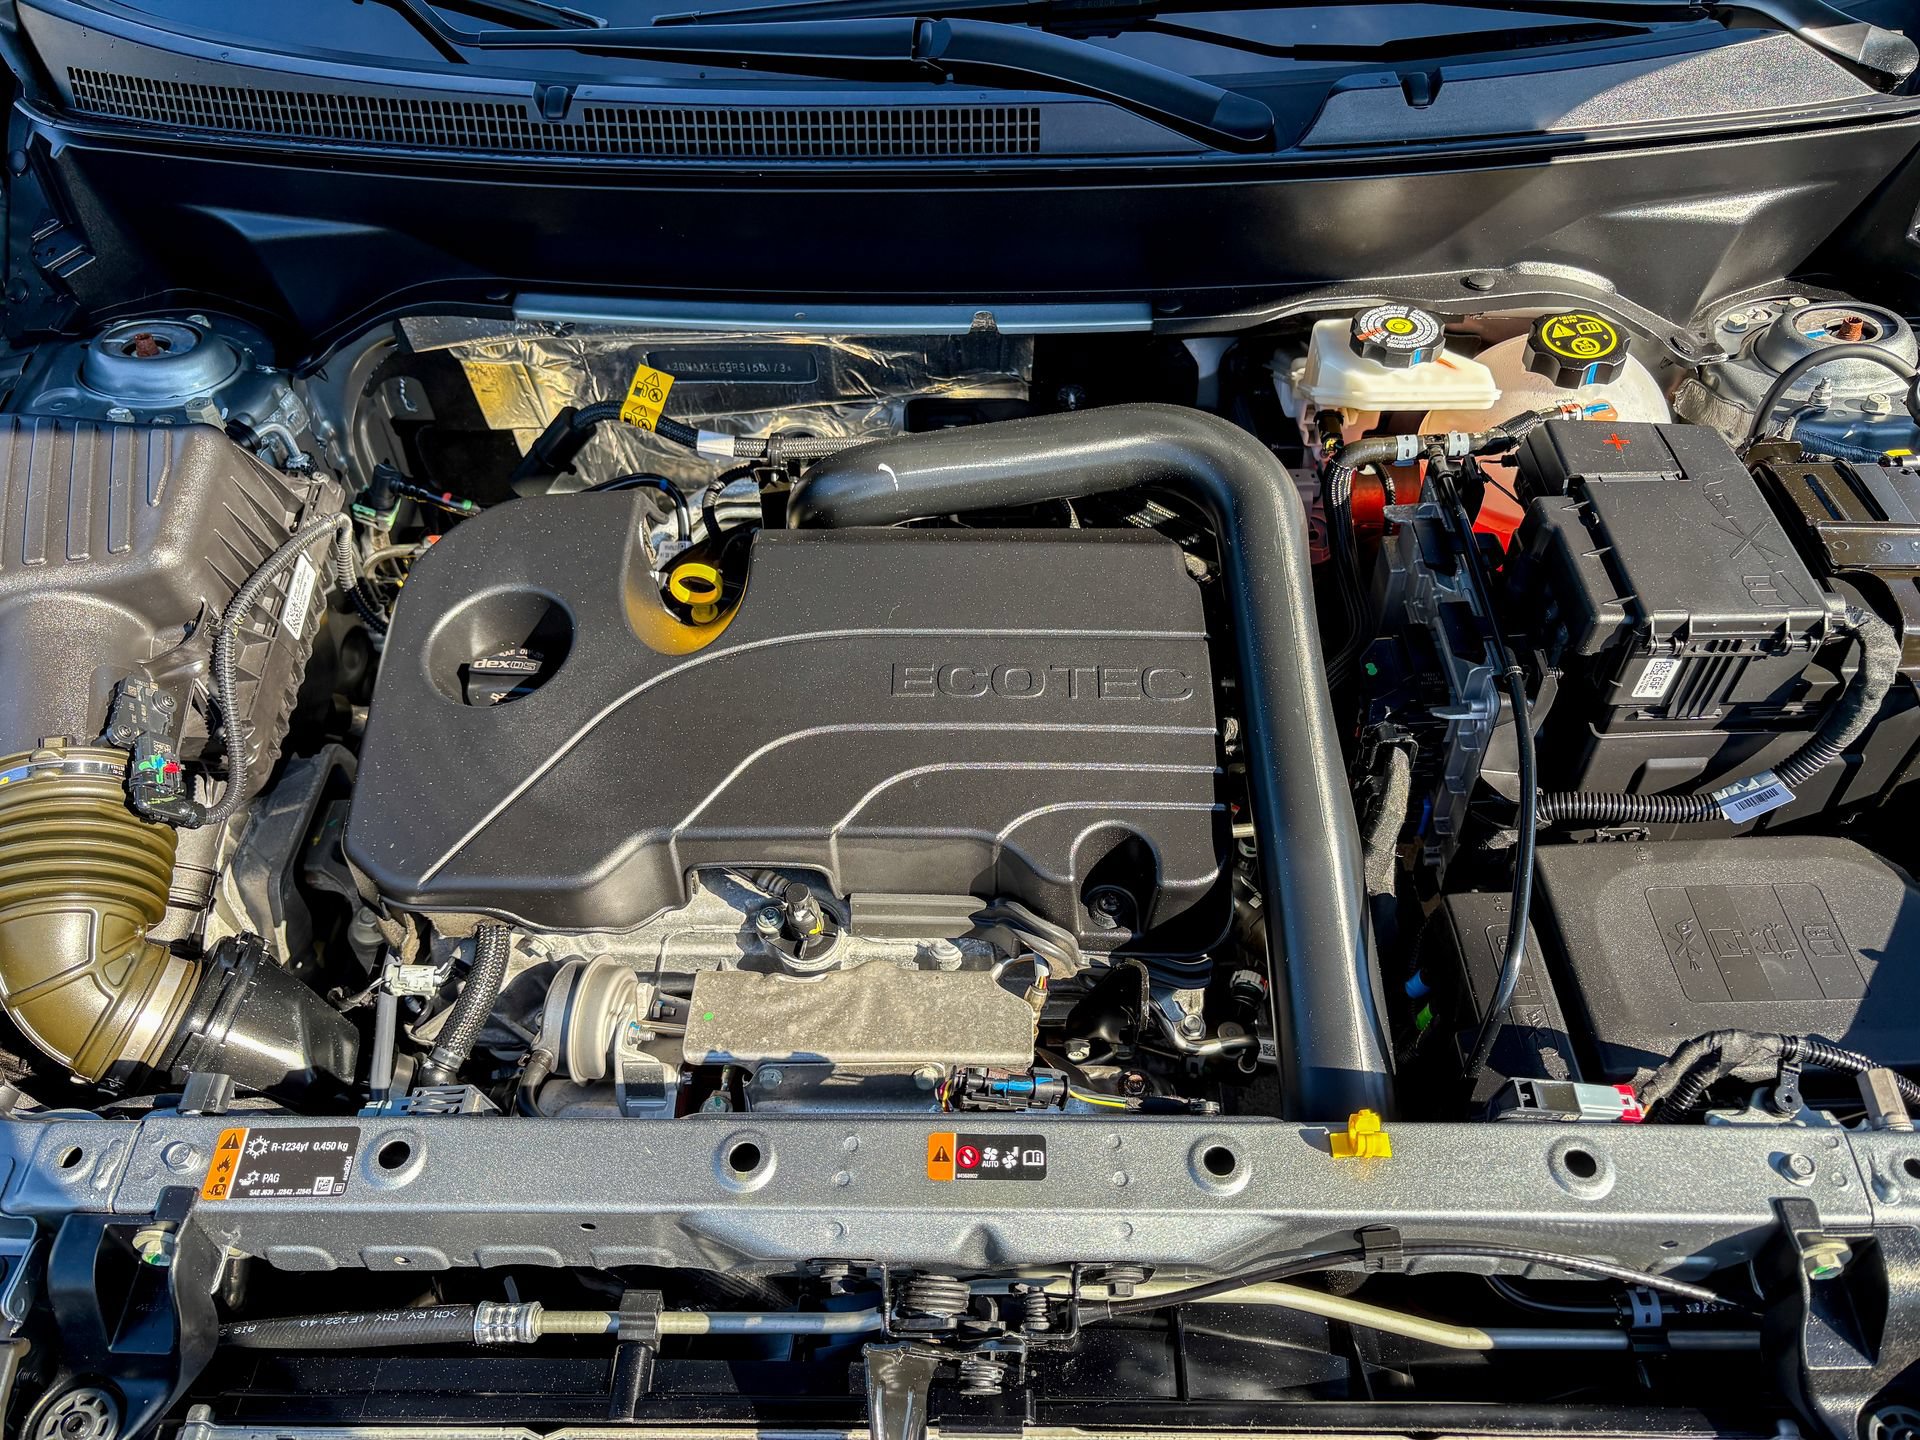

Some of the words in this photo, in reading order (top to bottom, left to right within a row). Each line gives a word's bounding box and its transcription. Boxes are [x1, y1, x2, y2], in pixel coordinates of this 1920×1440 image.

[473, 658, 537, 671] dexos
[890, 662, 1194, 701] ECOTEC
[271, 1141, 309, 1153] R-1234yf
[313, 1141, 337, 1151] 0.450
[337, 1140, 349, 1152] kg
[981, 1160, 999, 1168] AUTO
[262, 1173, 280, 1184] PAG
